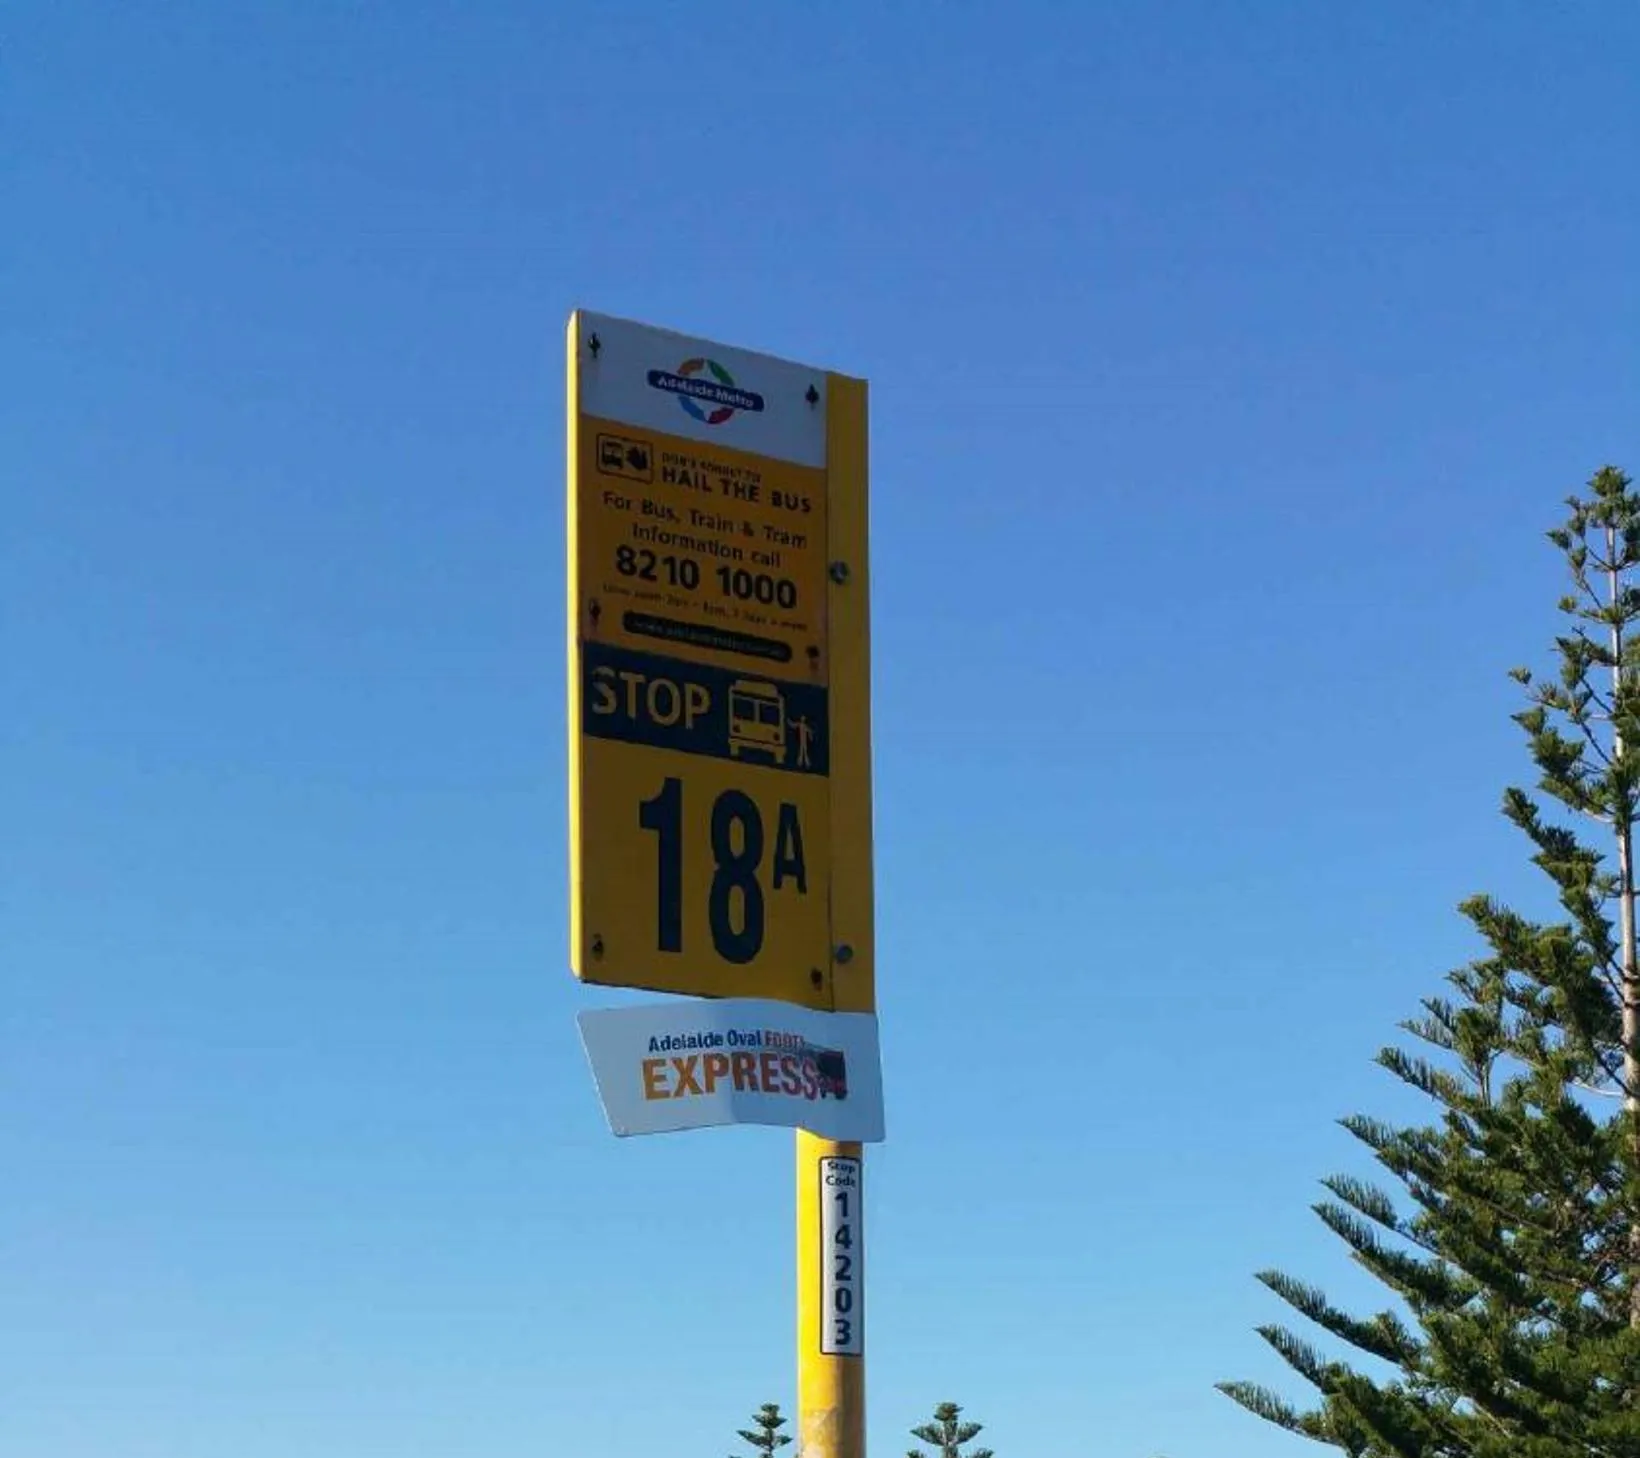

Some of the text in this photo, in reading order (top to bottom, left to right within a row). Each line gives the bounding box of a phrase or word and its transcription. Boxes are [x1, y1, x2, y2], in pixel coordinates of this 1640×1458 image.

[715, 387, 756, 409] Metro
[662, 466, 811, 514] HAIL THE BUS
[603, 491, 633, 511] For
[688, 509, 735, 534] Train
[740, 521, 755, 538] &
[764, 524, 808, 549] Tram
[632, 522, 782, 569] Information call
[615, 545, 700, 590] 8210
[716, 566, 798, 609] 1000
[591, 666, 711, 730] STOP
[648, 1031, 724, 1053] Adelaide
[727, 1029, 762, 1048] Oval
[641, 1052, 820, 1101] EXPRESS
[825, 1174, 856, 1187] Code
[827, 1160, 855, 1175] Stop
